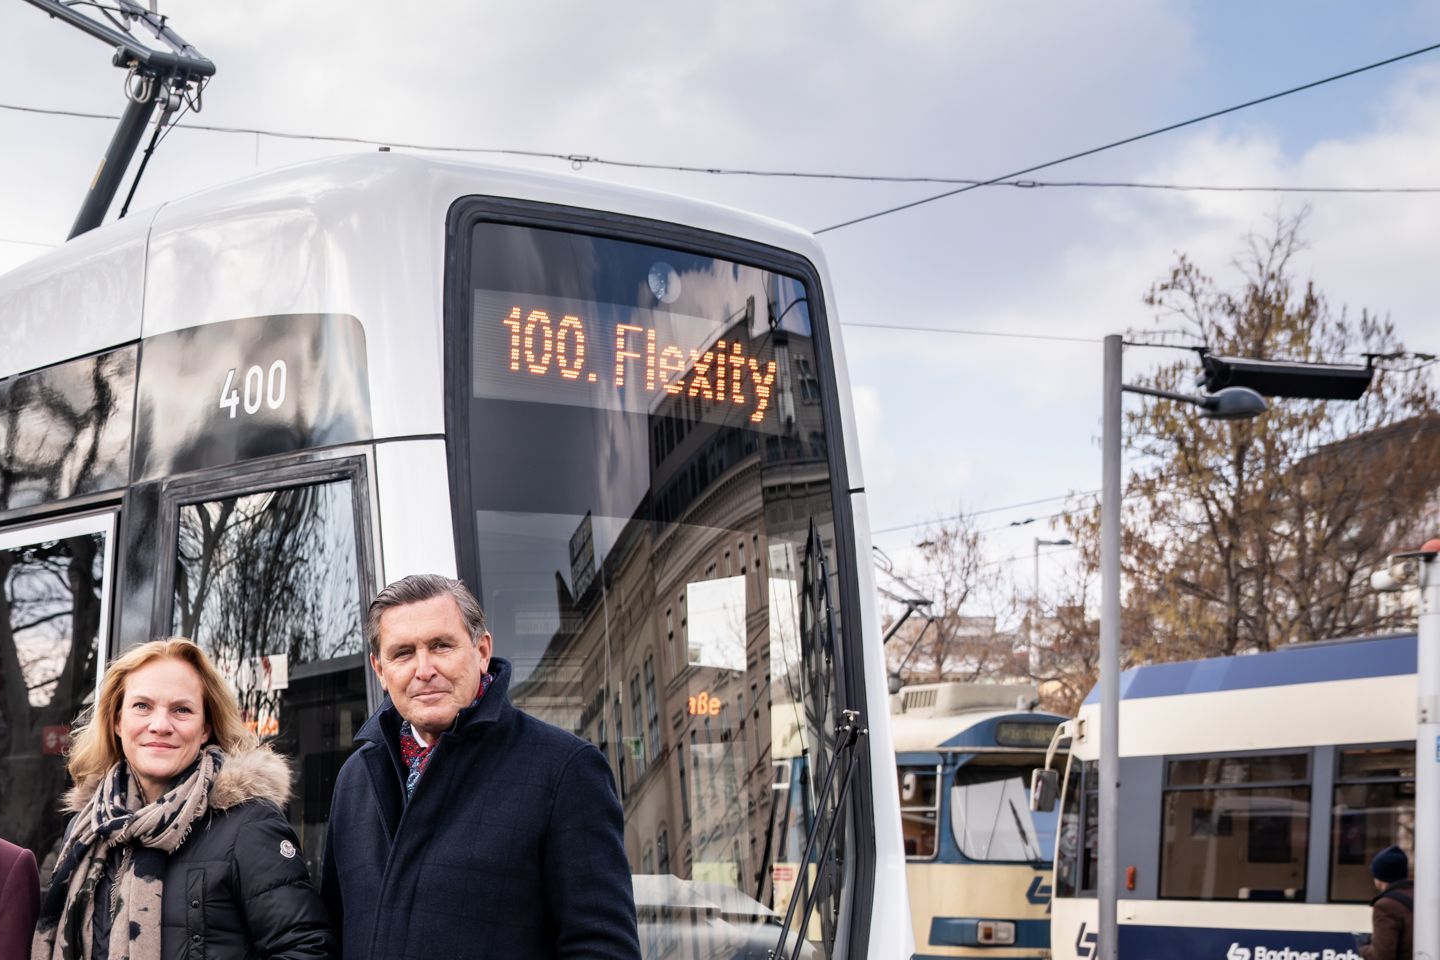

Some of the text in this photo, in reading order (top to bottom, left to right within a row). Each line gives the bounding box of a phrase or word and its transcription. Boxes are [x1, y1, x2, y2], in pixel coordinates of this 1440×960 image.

[219, 359, 288, 419] 400
[503, 306, 776, 423] 100. Flexity
